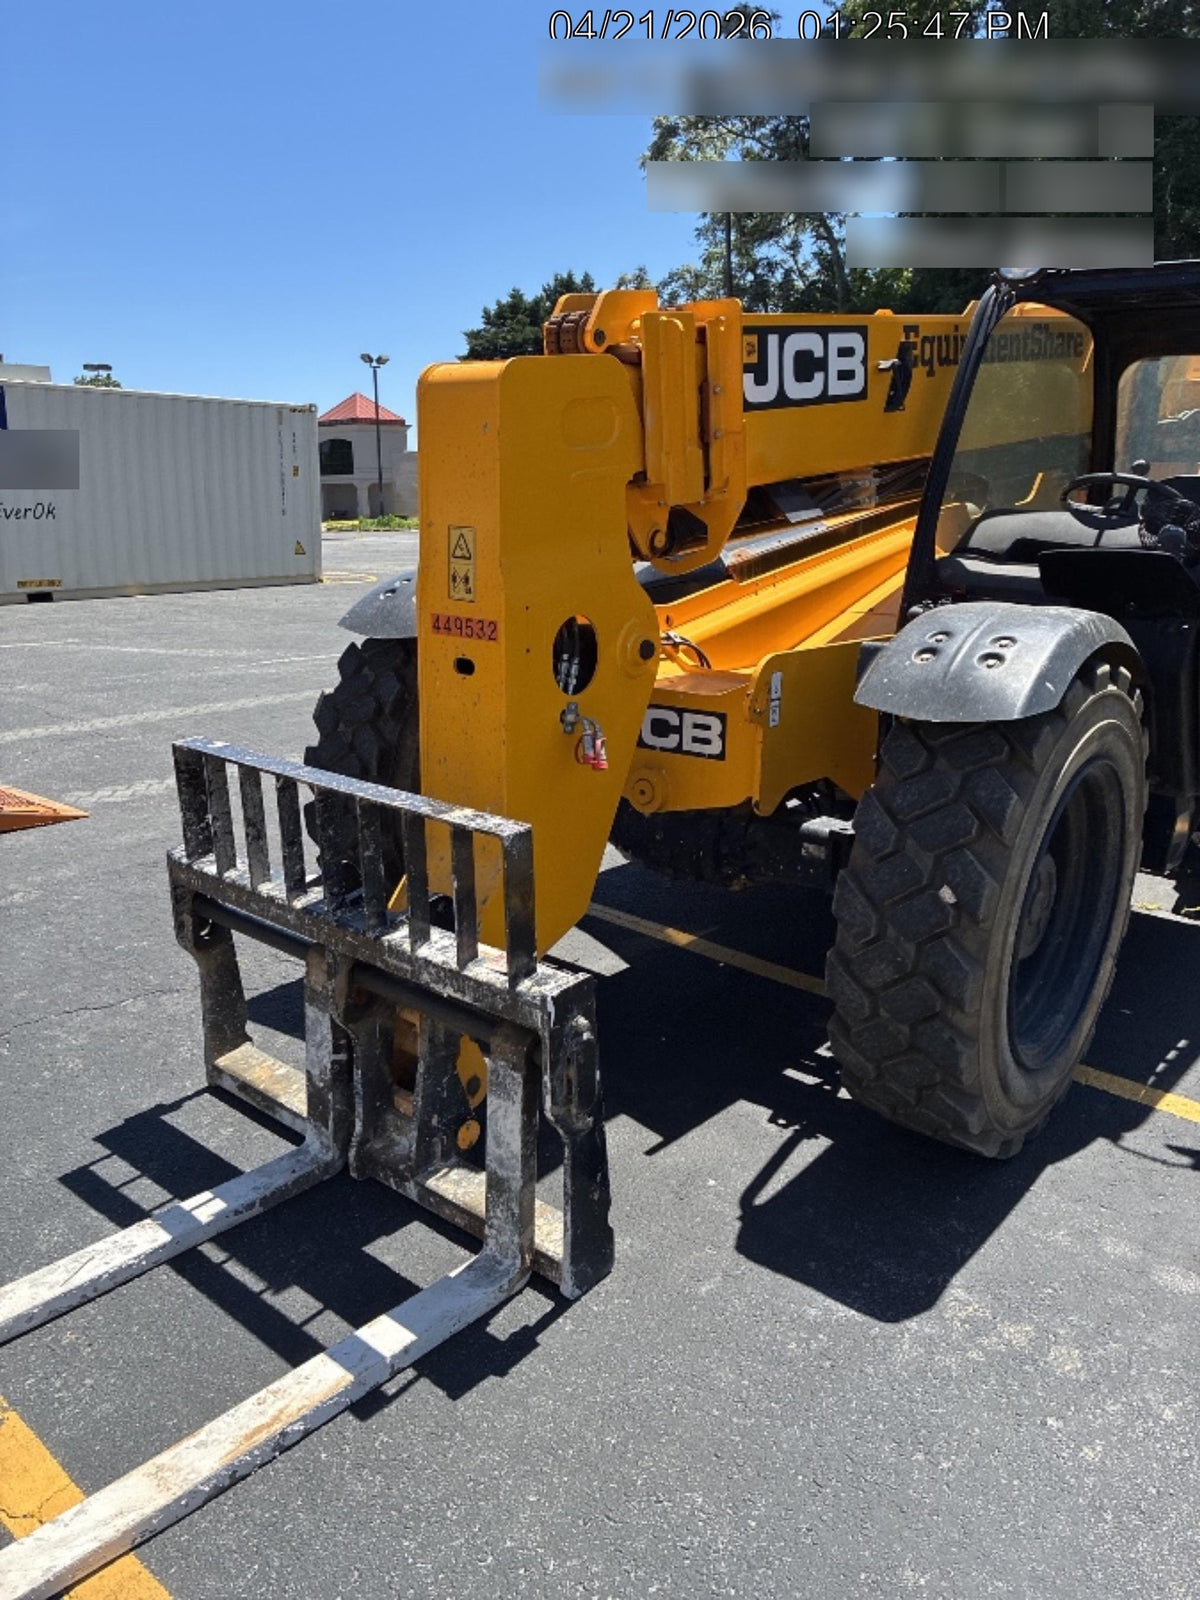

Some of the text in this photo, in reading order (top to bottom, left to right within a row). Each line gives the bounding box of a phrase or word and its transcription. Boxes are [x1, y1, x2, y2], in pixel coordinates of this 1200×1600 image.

[742, 332, 865, 403] JCB
[902, 323, 1084, 378] EquimentShare
[0, 501, 56, 520] verOk
[432, 615, 497, 641] 449532
[641, 708, 723, 755] CB
